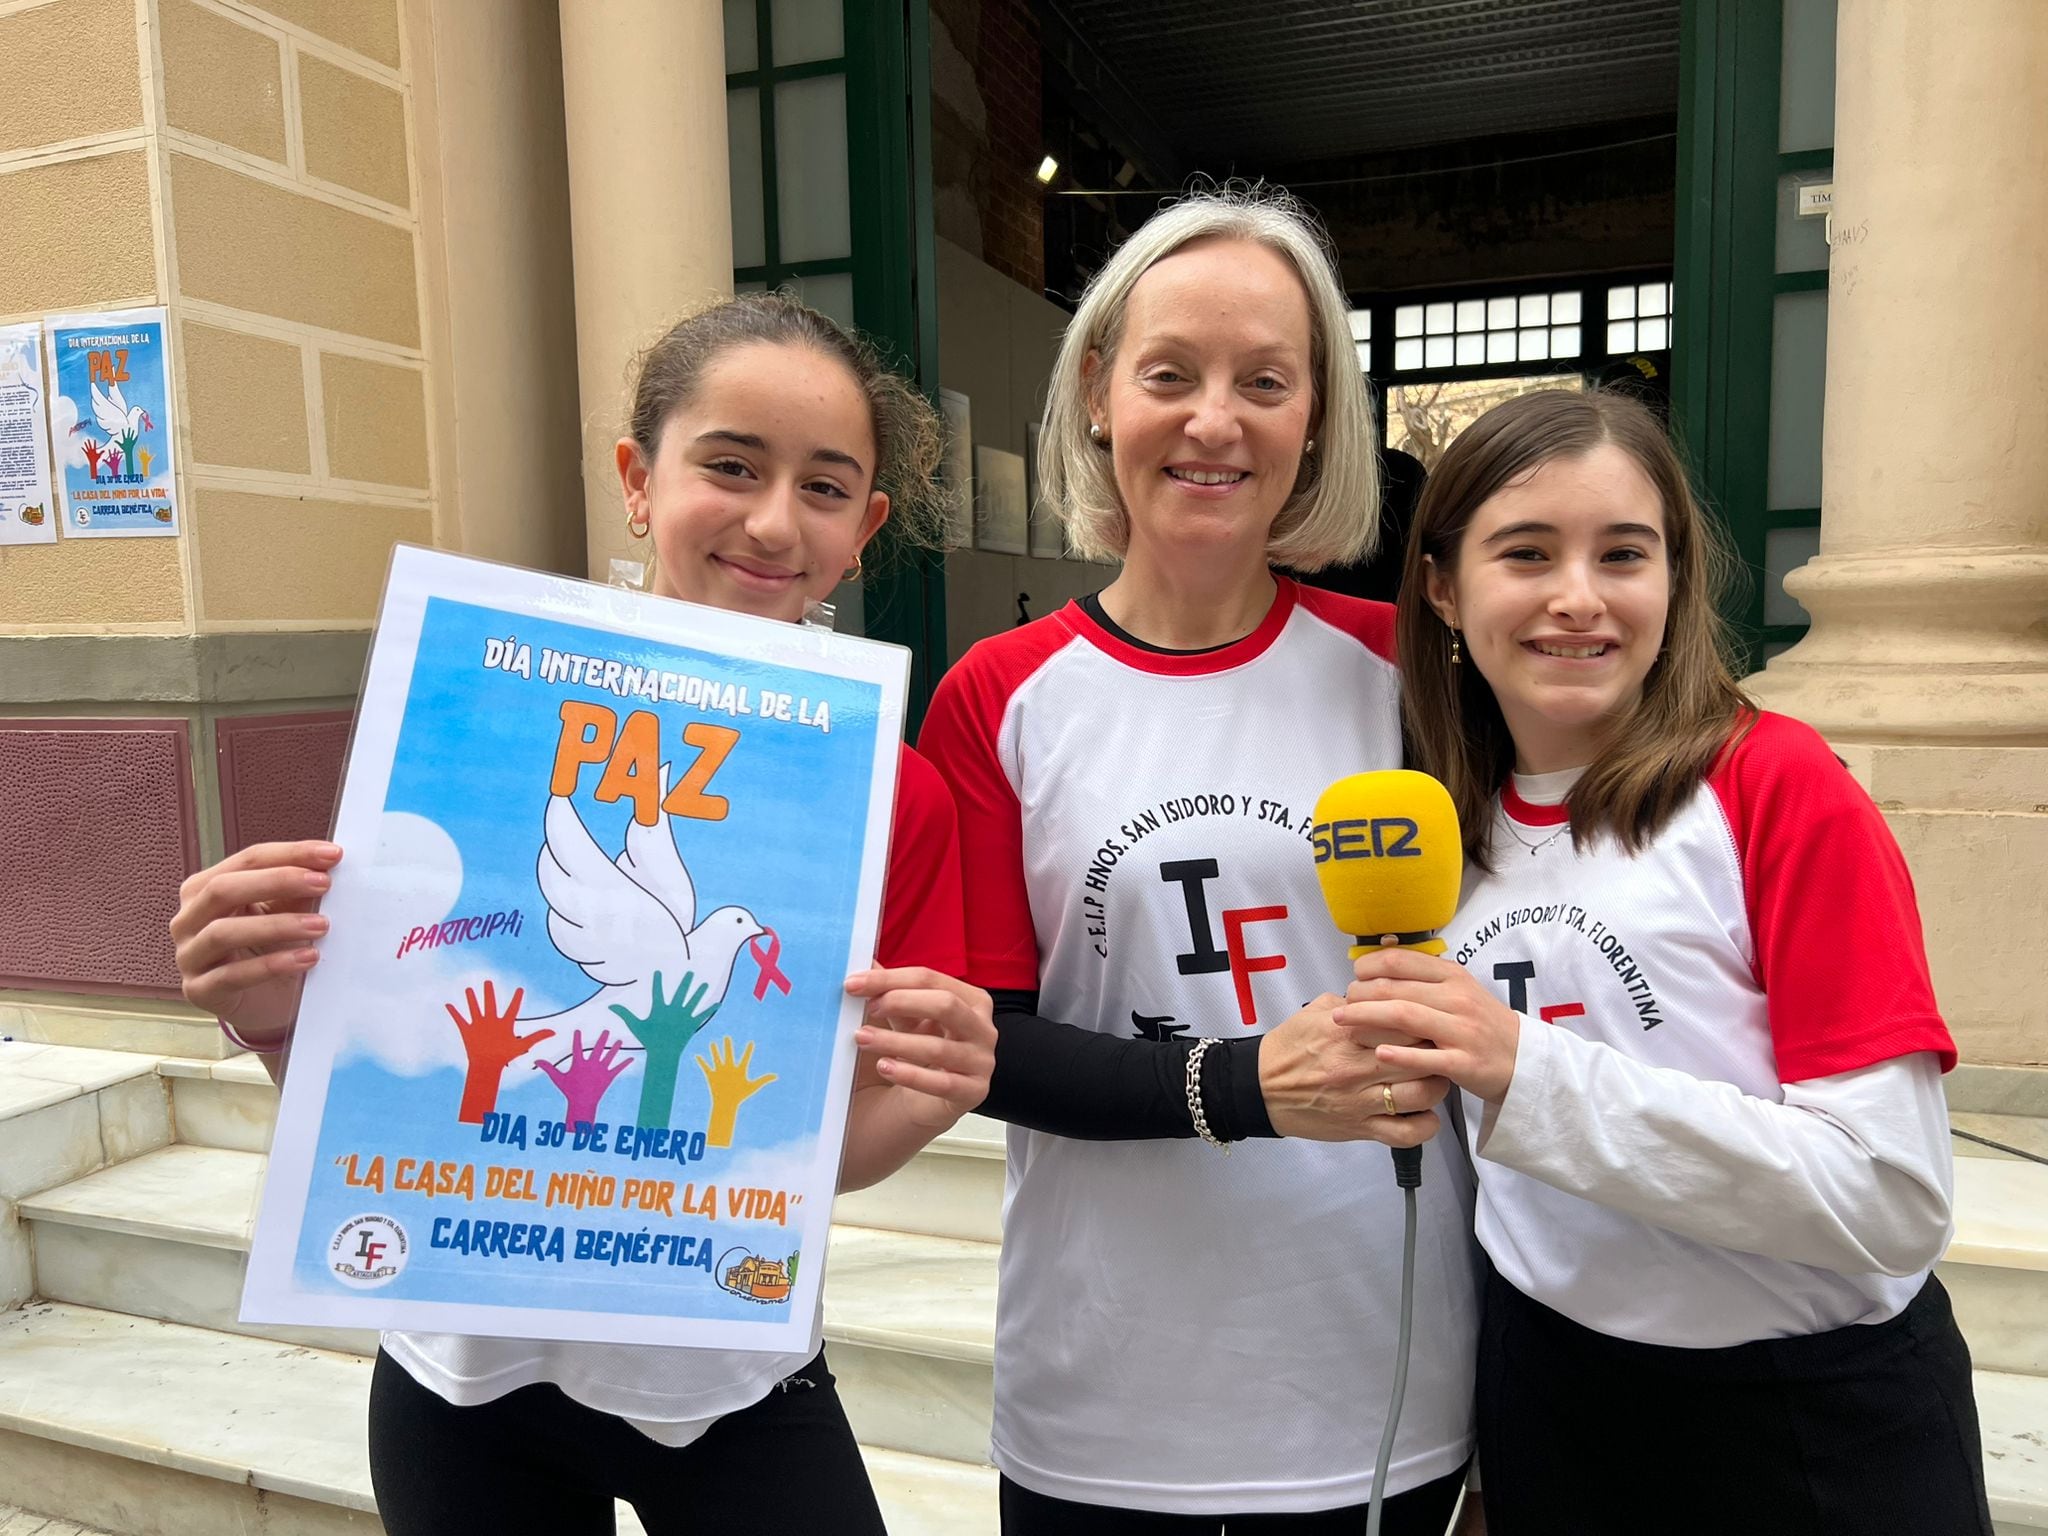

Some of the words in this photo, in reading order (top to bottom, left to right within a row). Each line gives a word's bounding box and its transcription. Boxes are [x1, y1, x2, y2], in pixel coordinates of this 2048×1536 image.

[131, 333, 140, 344] DE
[141, 333, 150, 344] LA
[87, 349, 130, 387] PAZ
[82, 490, 99, 501] CASA
[123, 473, 144, 485] ENERO
[92, 504, 120, 515] CARRERA
[483, 636, 532, 680] DÍA
[539, 648, 751, 717] INTERNACIONAL
[759, 689, 792, 721] DE
[798, 696, 831, 733] LA
[549, 700, 741, 827] PAZ
[1121, 809, 1161, 843] SAN
[1160, 793, 1235, 824] ISIDORO
[1242, 795, 1252, 816] Y
[1258, 799, 1293, 830] STA.
[1312, 817, 1422, 864] SER
[1085, 839, 1130, 892] HNOS.
[1083, 896, 1108, 958] C.E.I.P
[1159, 857, 1288, 1025] IF
[1475, 917, 1501, 947] SAN
[1506, 904, 1556, 929] ISIDORO
[1556, 903, 1567, 922] Y
[1566, 905, 1586, 933] STA.
[1588, 921, 1664, 1031] FLORENTINA
[480, 1111, 527, 1150] DIA
[535, 1120, 567, 1148] 30
[572, 1120, 609, 1153] DE
[614, 1125, 707, 1165] ENERO
[394, 1158, 474, 1201] CASA
[485, 1166, 538, 1200] DEL
[545, 1169, 616, 1210] NIÑO
[622, 1178, 675, 1217] POR
[682, 1182, 717, 1221] LA
[430, 1216, 565, 1263] CARRERA
[574, 1227, 713, 1273] BENÉFICA
